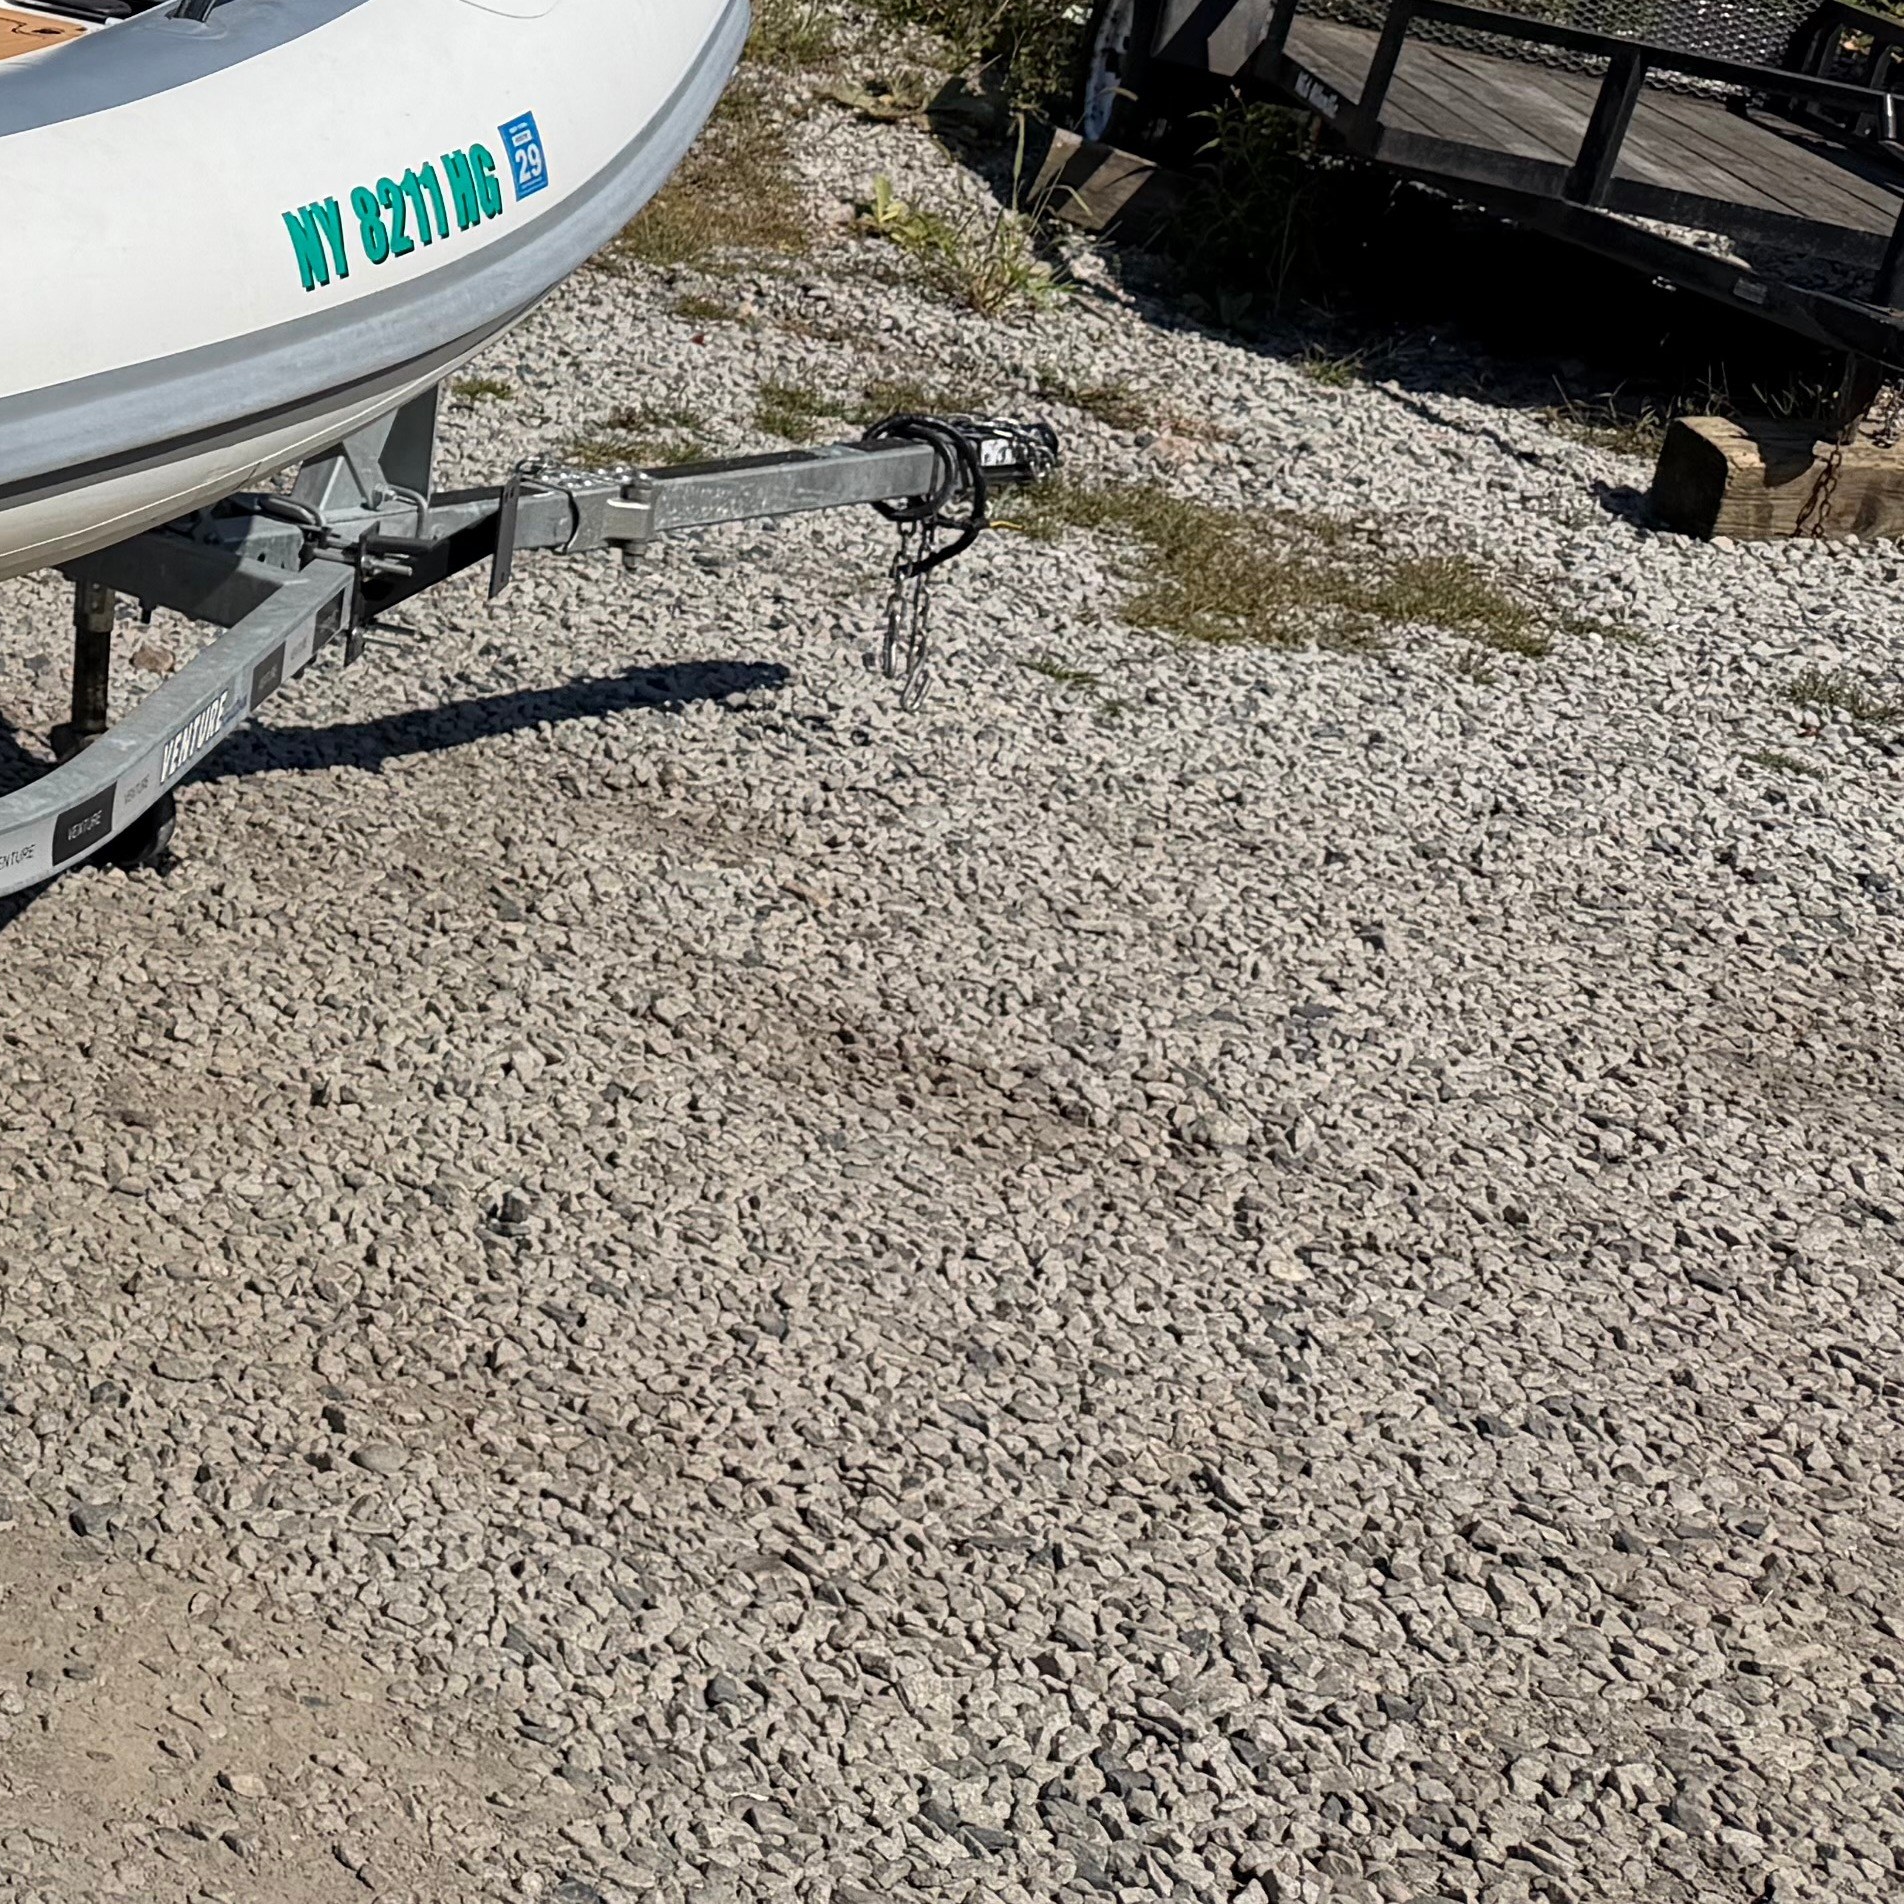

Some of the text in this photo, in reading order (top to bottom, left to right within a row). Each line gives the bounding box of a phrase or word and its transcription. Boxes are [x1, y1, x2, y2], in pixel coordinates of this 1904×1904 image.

[514, 143, 542, 184] 29
[282, 143, 503, 292] NY 8211 HG
[160, 689, 229, 783] VENTURE
